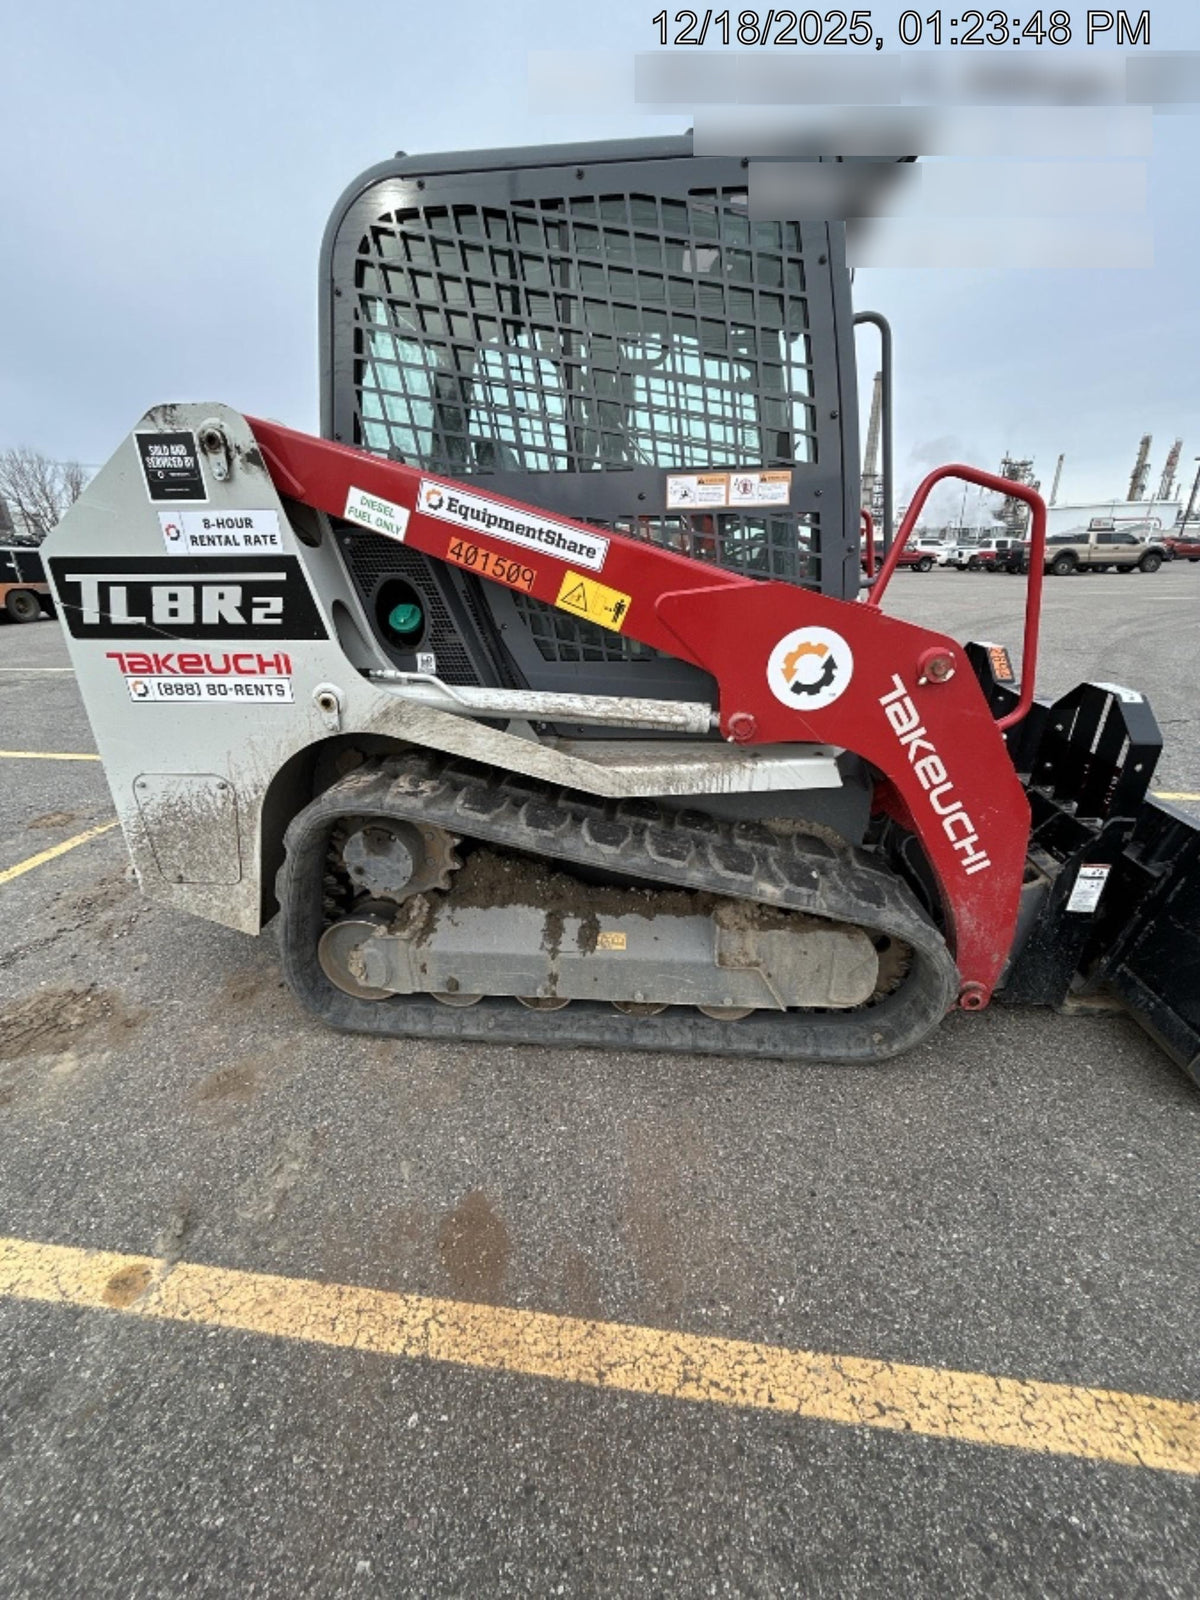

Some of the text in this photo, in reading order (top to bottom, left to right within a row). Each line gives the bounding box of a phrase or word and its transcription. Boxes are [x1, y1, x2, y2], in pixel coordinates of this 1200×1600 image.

[360, 495, 395, 518] DIESEL
[202, 518, 254, 529] 8-HOUR
[347, 506, 402, 535] FUEL ONLY
[447, 496, 597, 559] EquipmentShare
[189, 534, 278, 546] RENTAL RATE
[449, 542, 535, 591] 401509
[65, 572, 287, 625] TL8R2
[157, 682, 285, 696] (888) 80-RENTS
